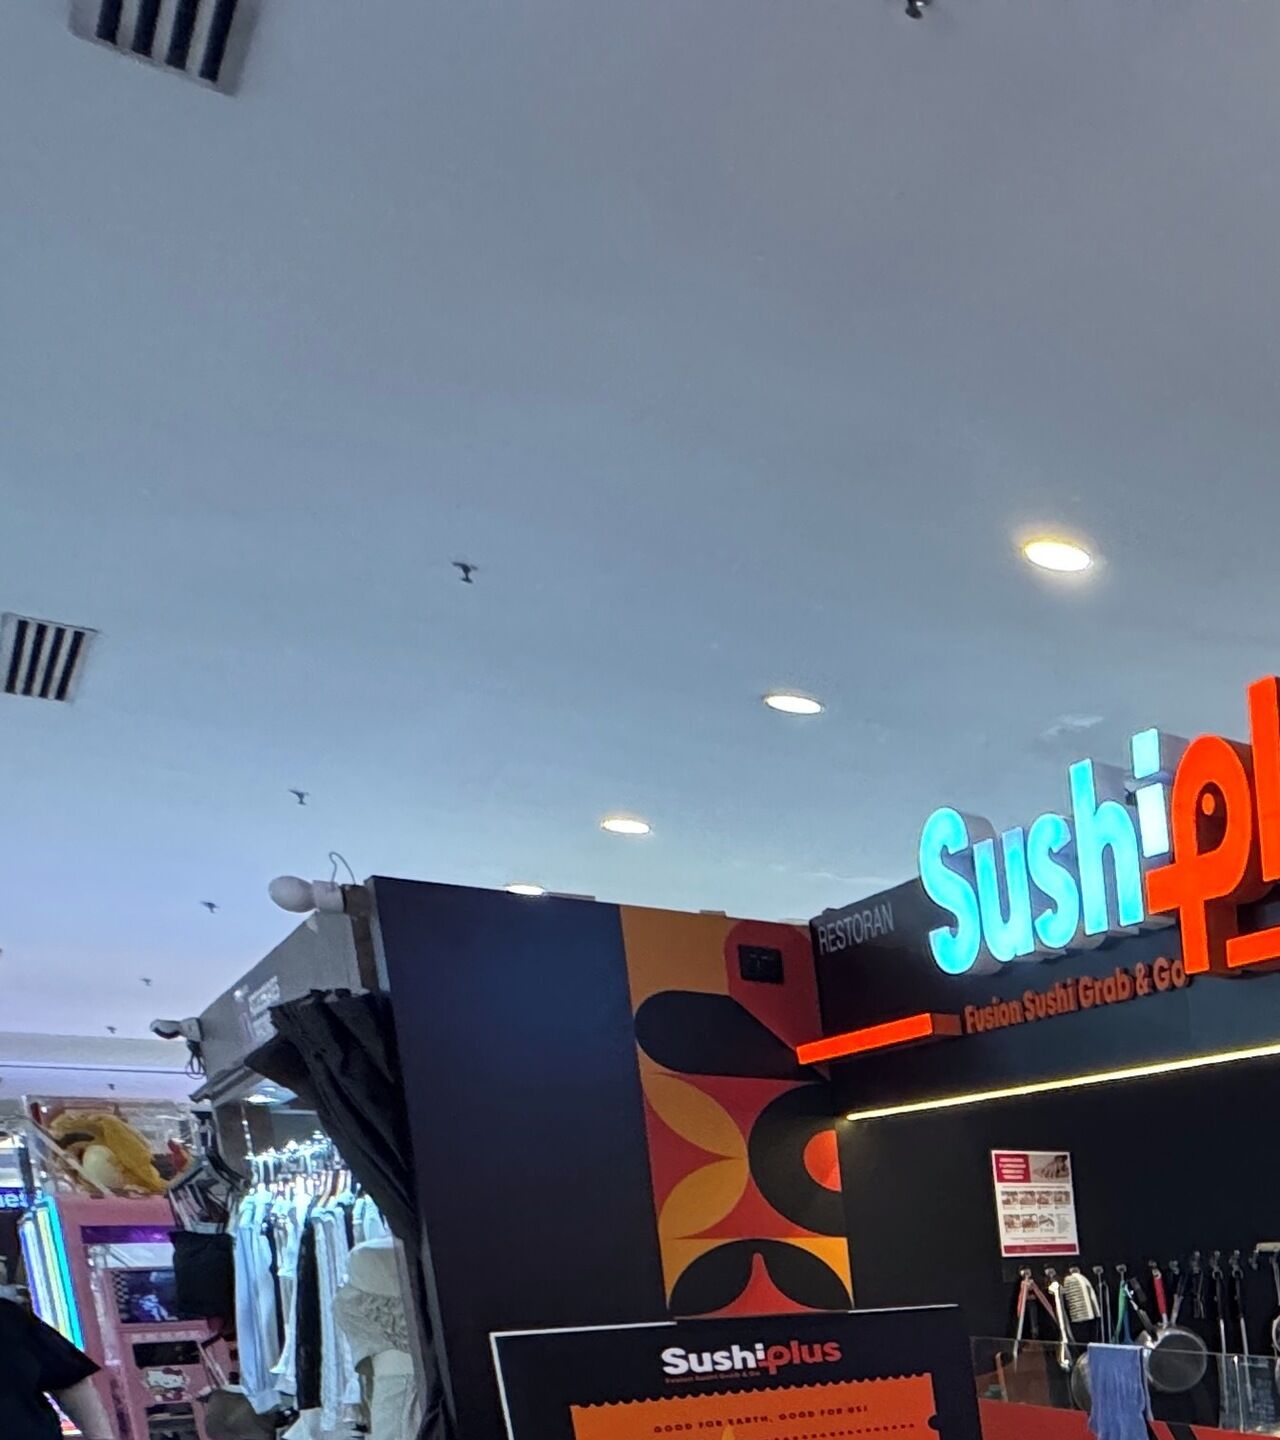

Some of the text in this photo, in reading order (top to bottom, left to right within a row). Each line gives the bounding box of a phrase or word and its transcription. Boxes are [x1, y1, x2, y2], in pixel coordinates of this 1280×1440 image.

[818, 902, 894, 956] RESTORAN
[965, 957, 1187, 1034] Fusion Sushi Grab & Go
[661, 1339, 843, 1376] Sushiplus
[654, 1422, 693, 1433] GOOD
[699, 1420, 723, 1430] FOR
[779, 1410, 815, 1421] GOOD
[820, 1407, 842, 1417] FOR
